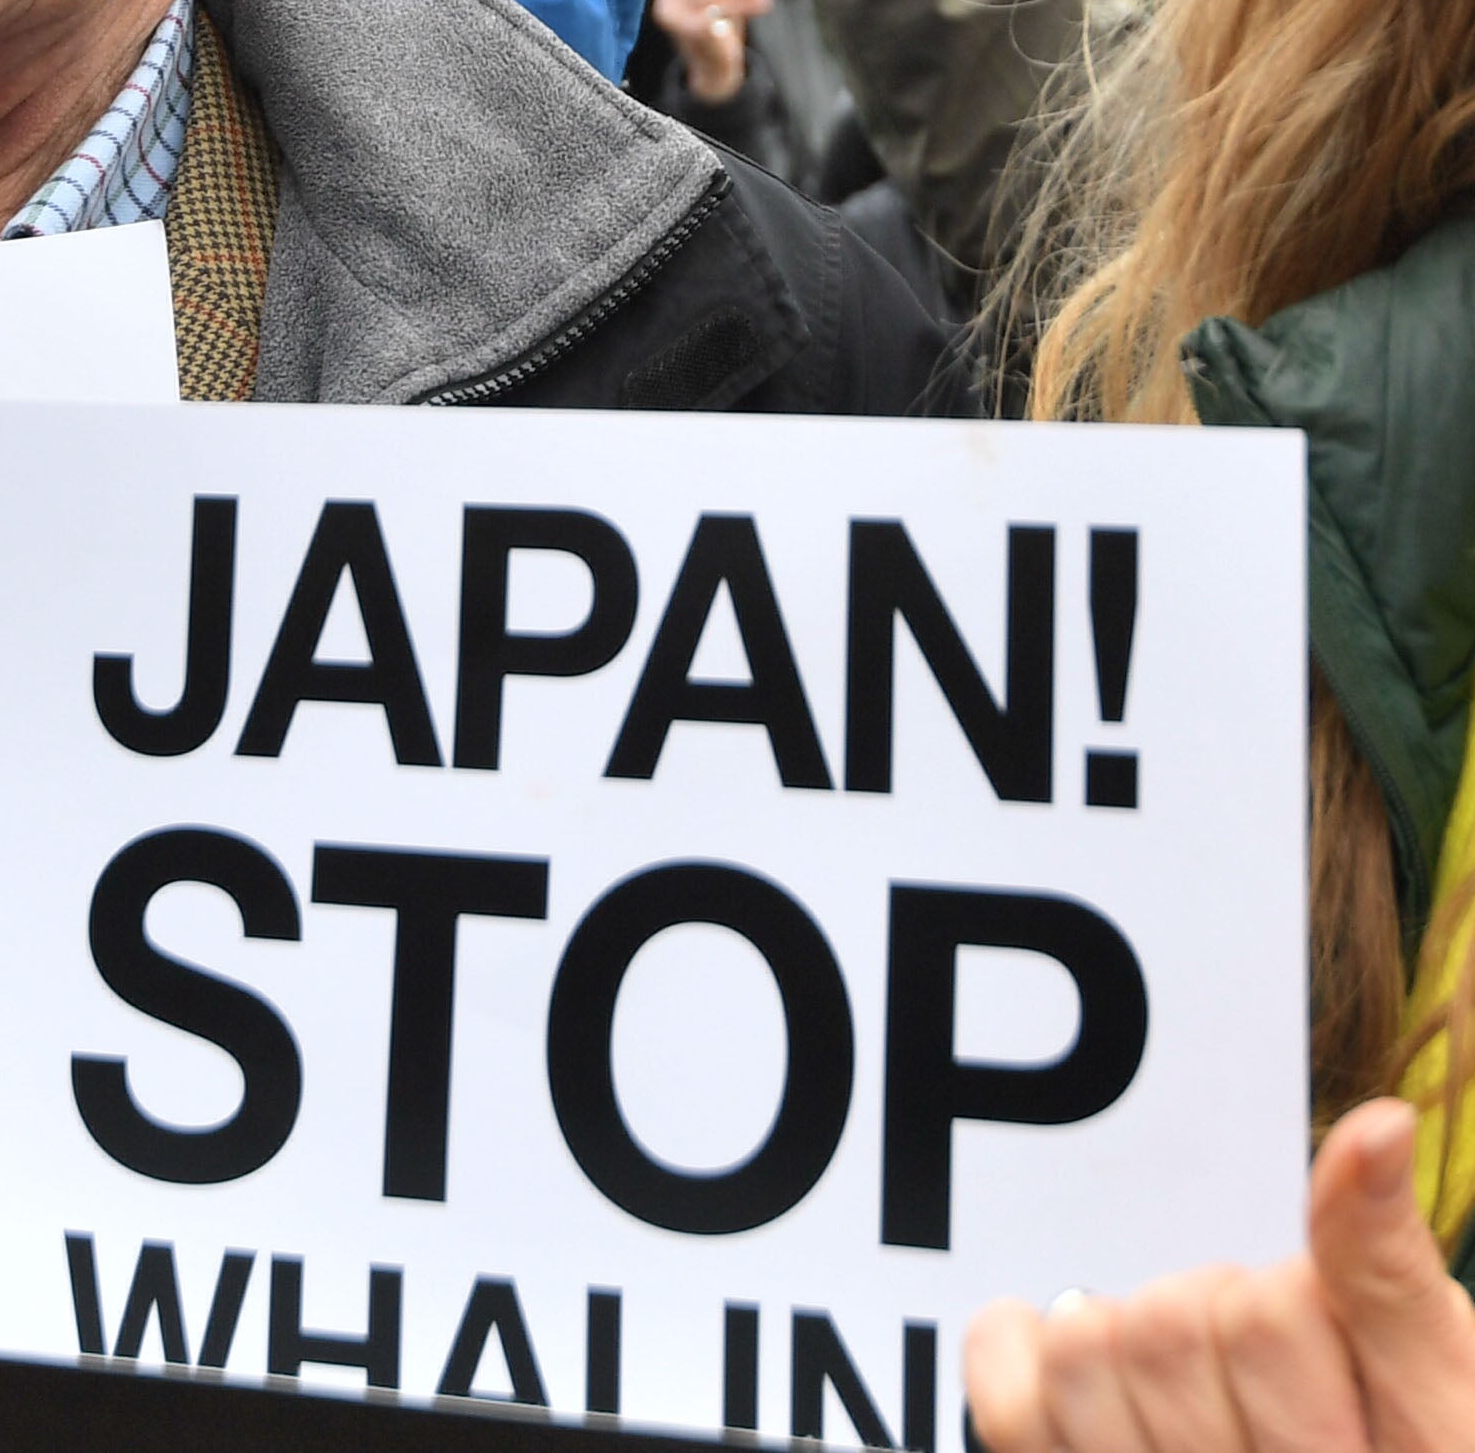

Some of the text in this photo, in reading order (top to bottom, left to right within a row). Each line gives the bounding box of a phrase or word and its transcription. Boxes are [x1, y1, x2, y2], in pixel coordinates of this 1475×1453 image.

[92, 495, 1141, 809] JAPAN!
[70, 824, 1149, 1251] STOP
[65, 1229, 991, 1453] WHALIN
